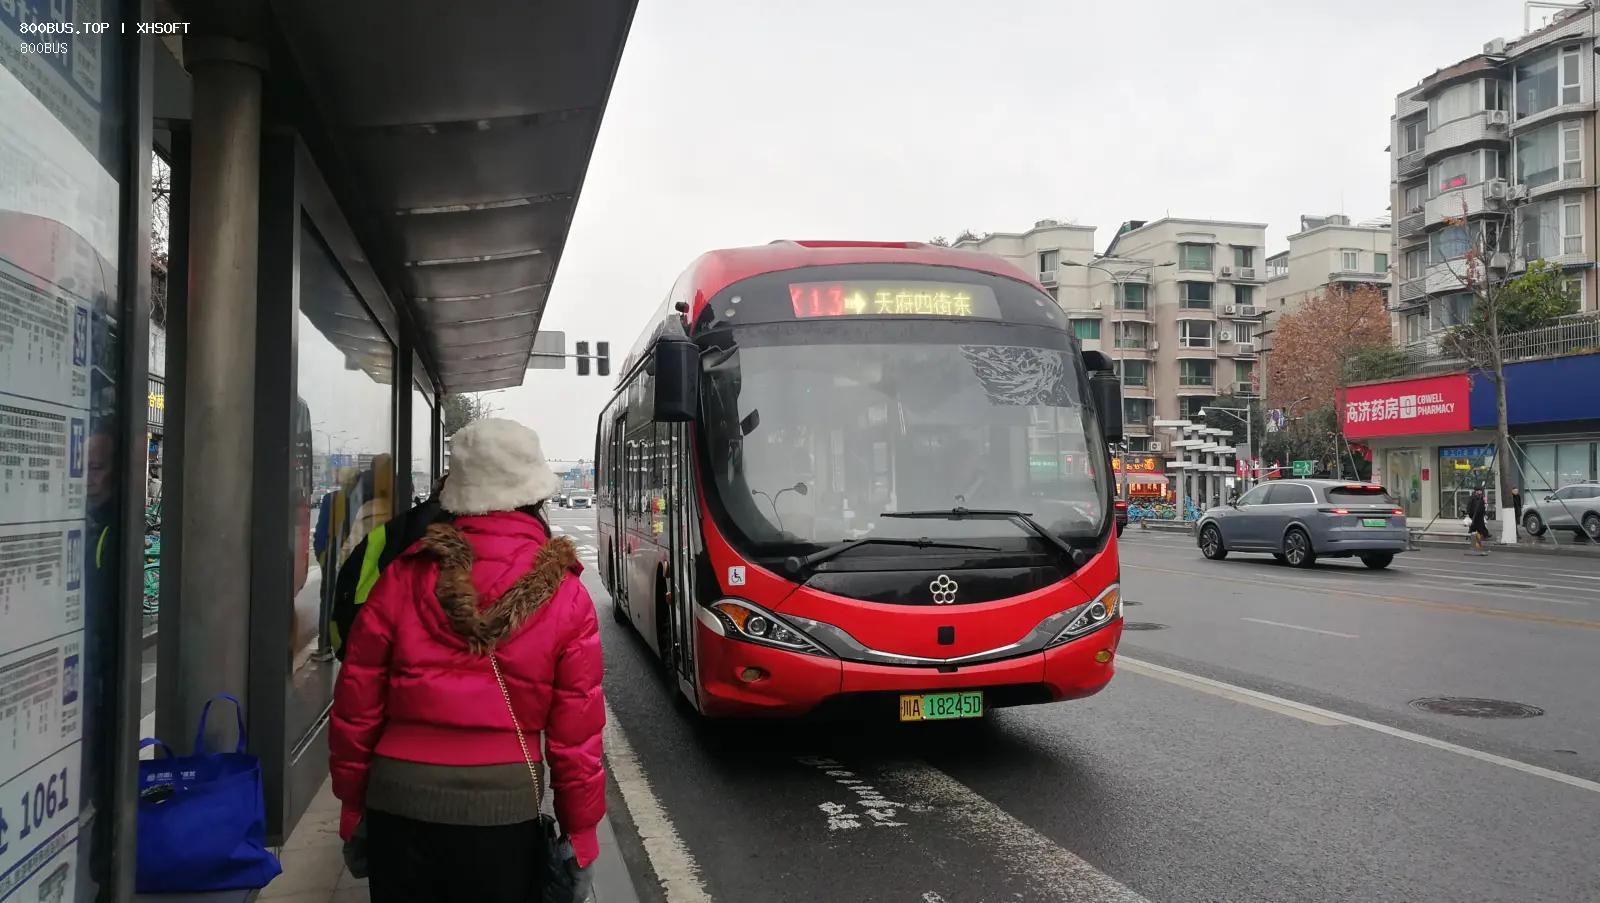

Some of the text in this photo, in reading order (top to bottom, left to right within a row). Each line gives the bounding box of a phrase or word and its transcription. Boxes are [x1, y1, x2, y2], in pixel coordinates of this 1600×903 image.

[874, 291, 973, 316] 天府四街东
[1346, 397, 1399, 423] 高济药房
[1417, 403, 1455, 416] PHARMACY
[929, 695, 981, 716] 18245D
[19, 766, 69, 840] 1061
